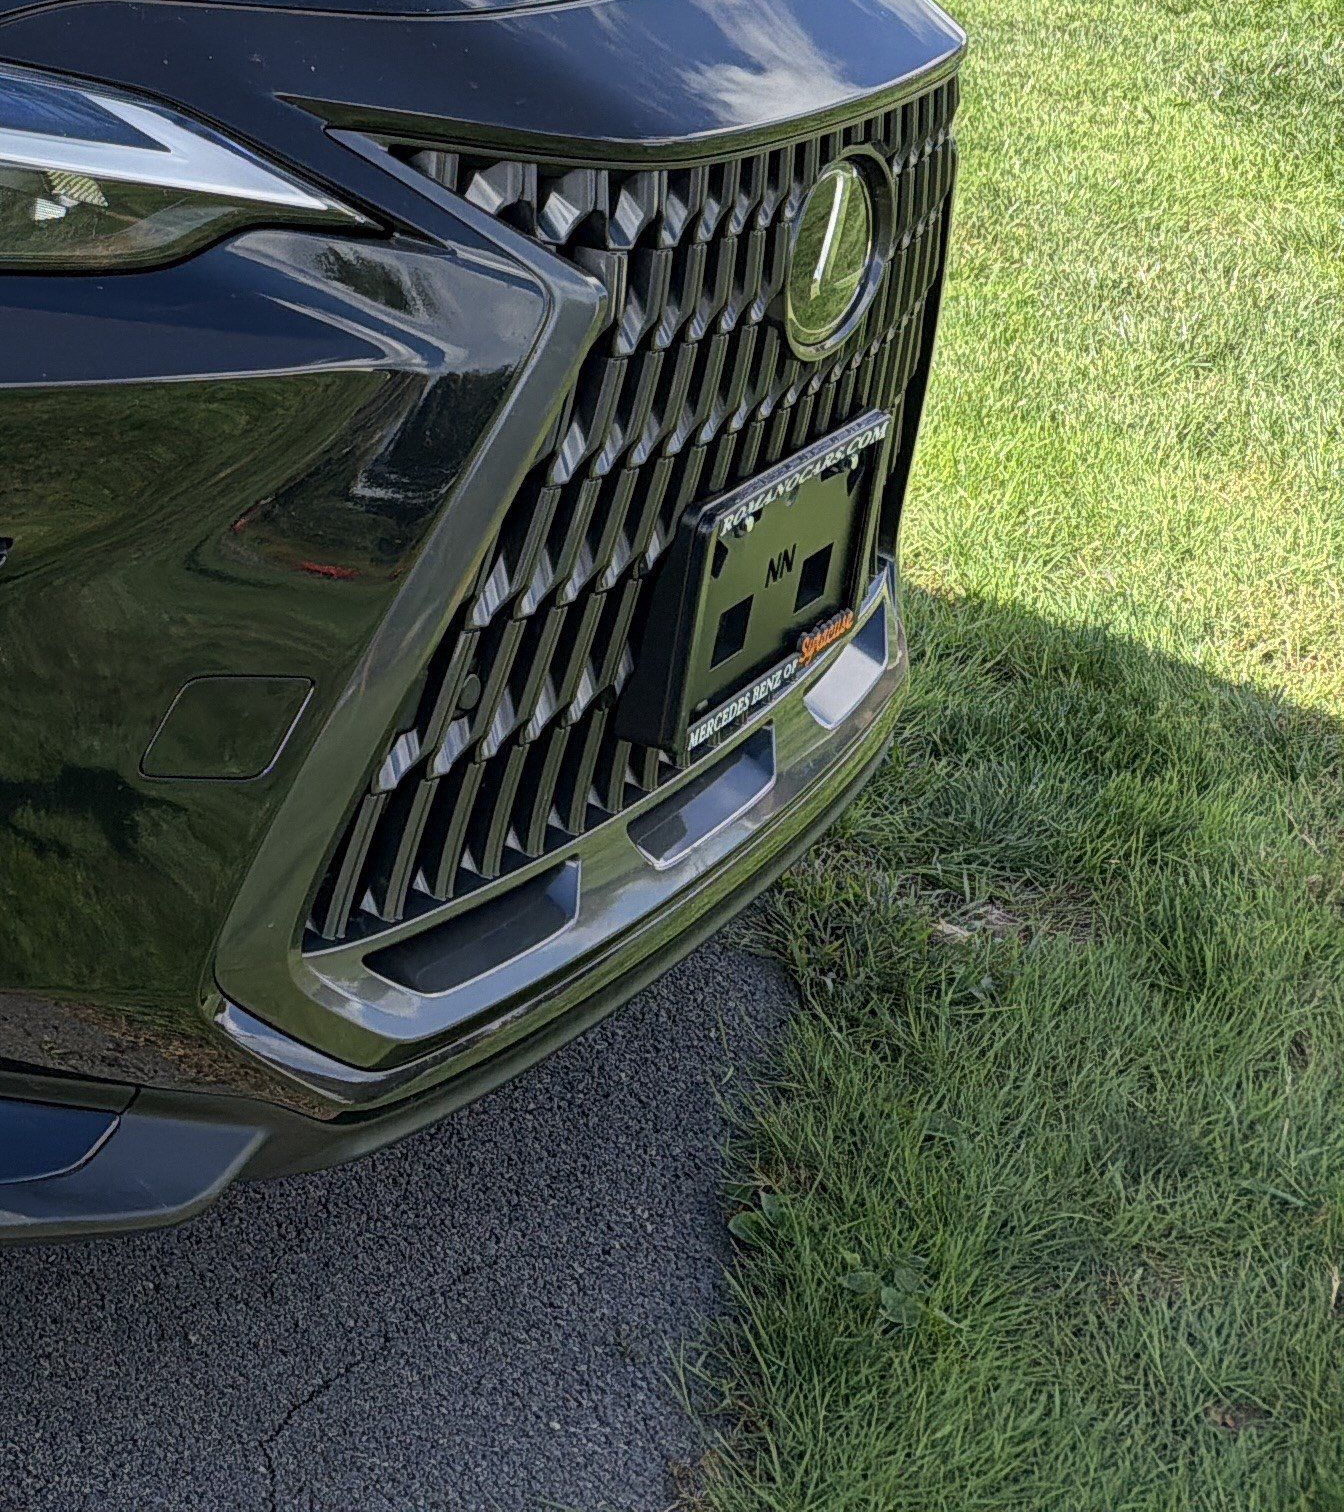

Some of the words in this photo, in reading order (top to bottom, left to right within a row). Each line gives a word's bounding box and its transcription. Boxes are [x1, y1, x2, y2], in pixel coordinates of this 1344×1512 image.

[719, 420, 890, 538] ROMANOCARS.COM
[688, 691, 751, 751] MERCEDES
[751, 669, 783, 706] BENZ
